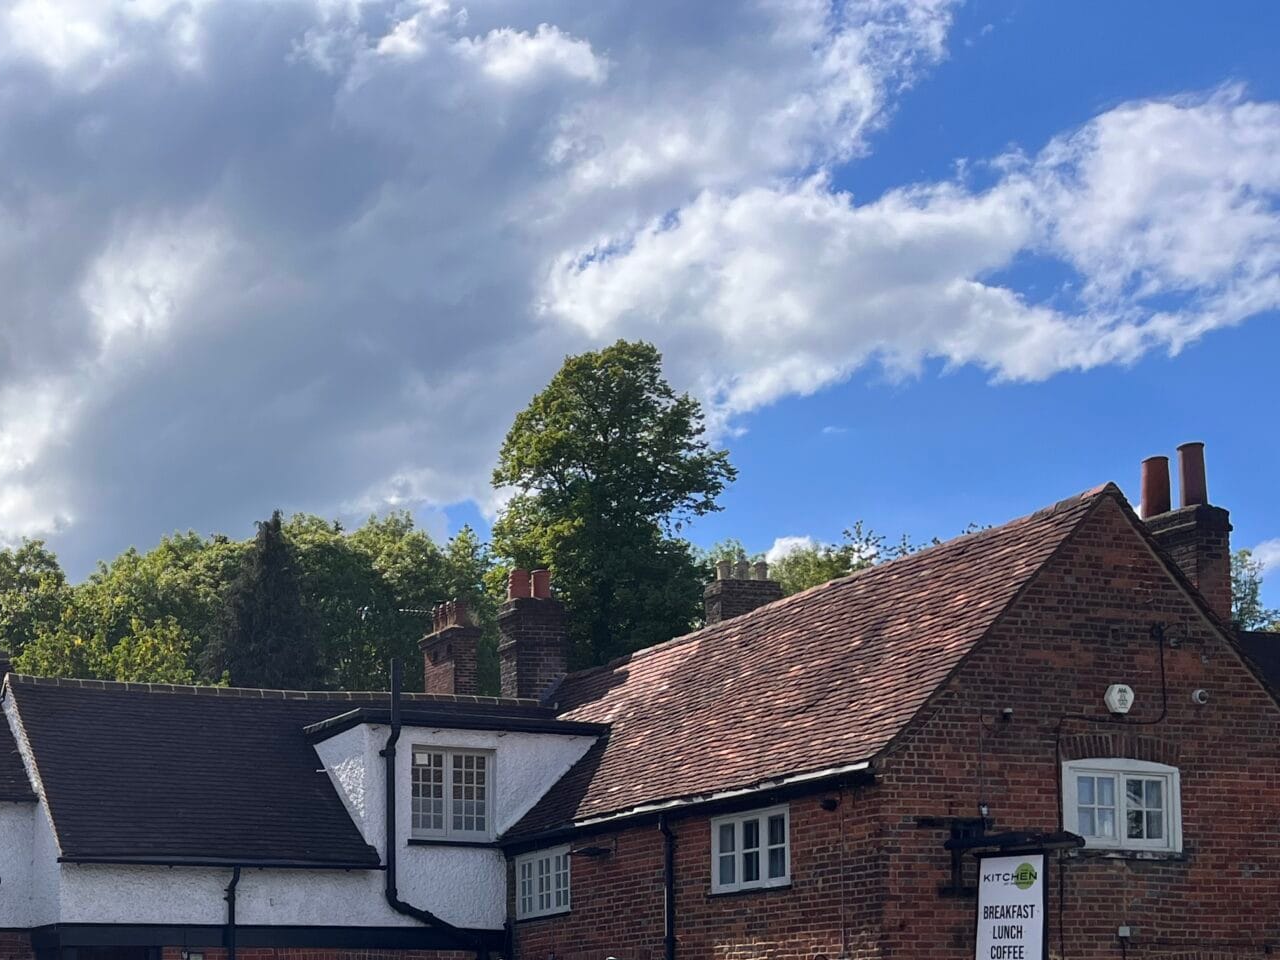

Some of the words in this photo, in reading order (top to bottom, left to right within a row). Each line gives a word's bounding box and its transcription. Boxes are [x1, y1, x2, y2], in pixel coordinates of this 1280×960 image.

[983, 871, 1038, 882] KITCHEN
[983, 904, 1036, 920] BREAKFAST
[992, 924, 1023, 940] LUNCH
[990, 945, 1025, 960] COFFEE
